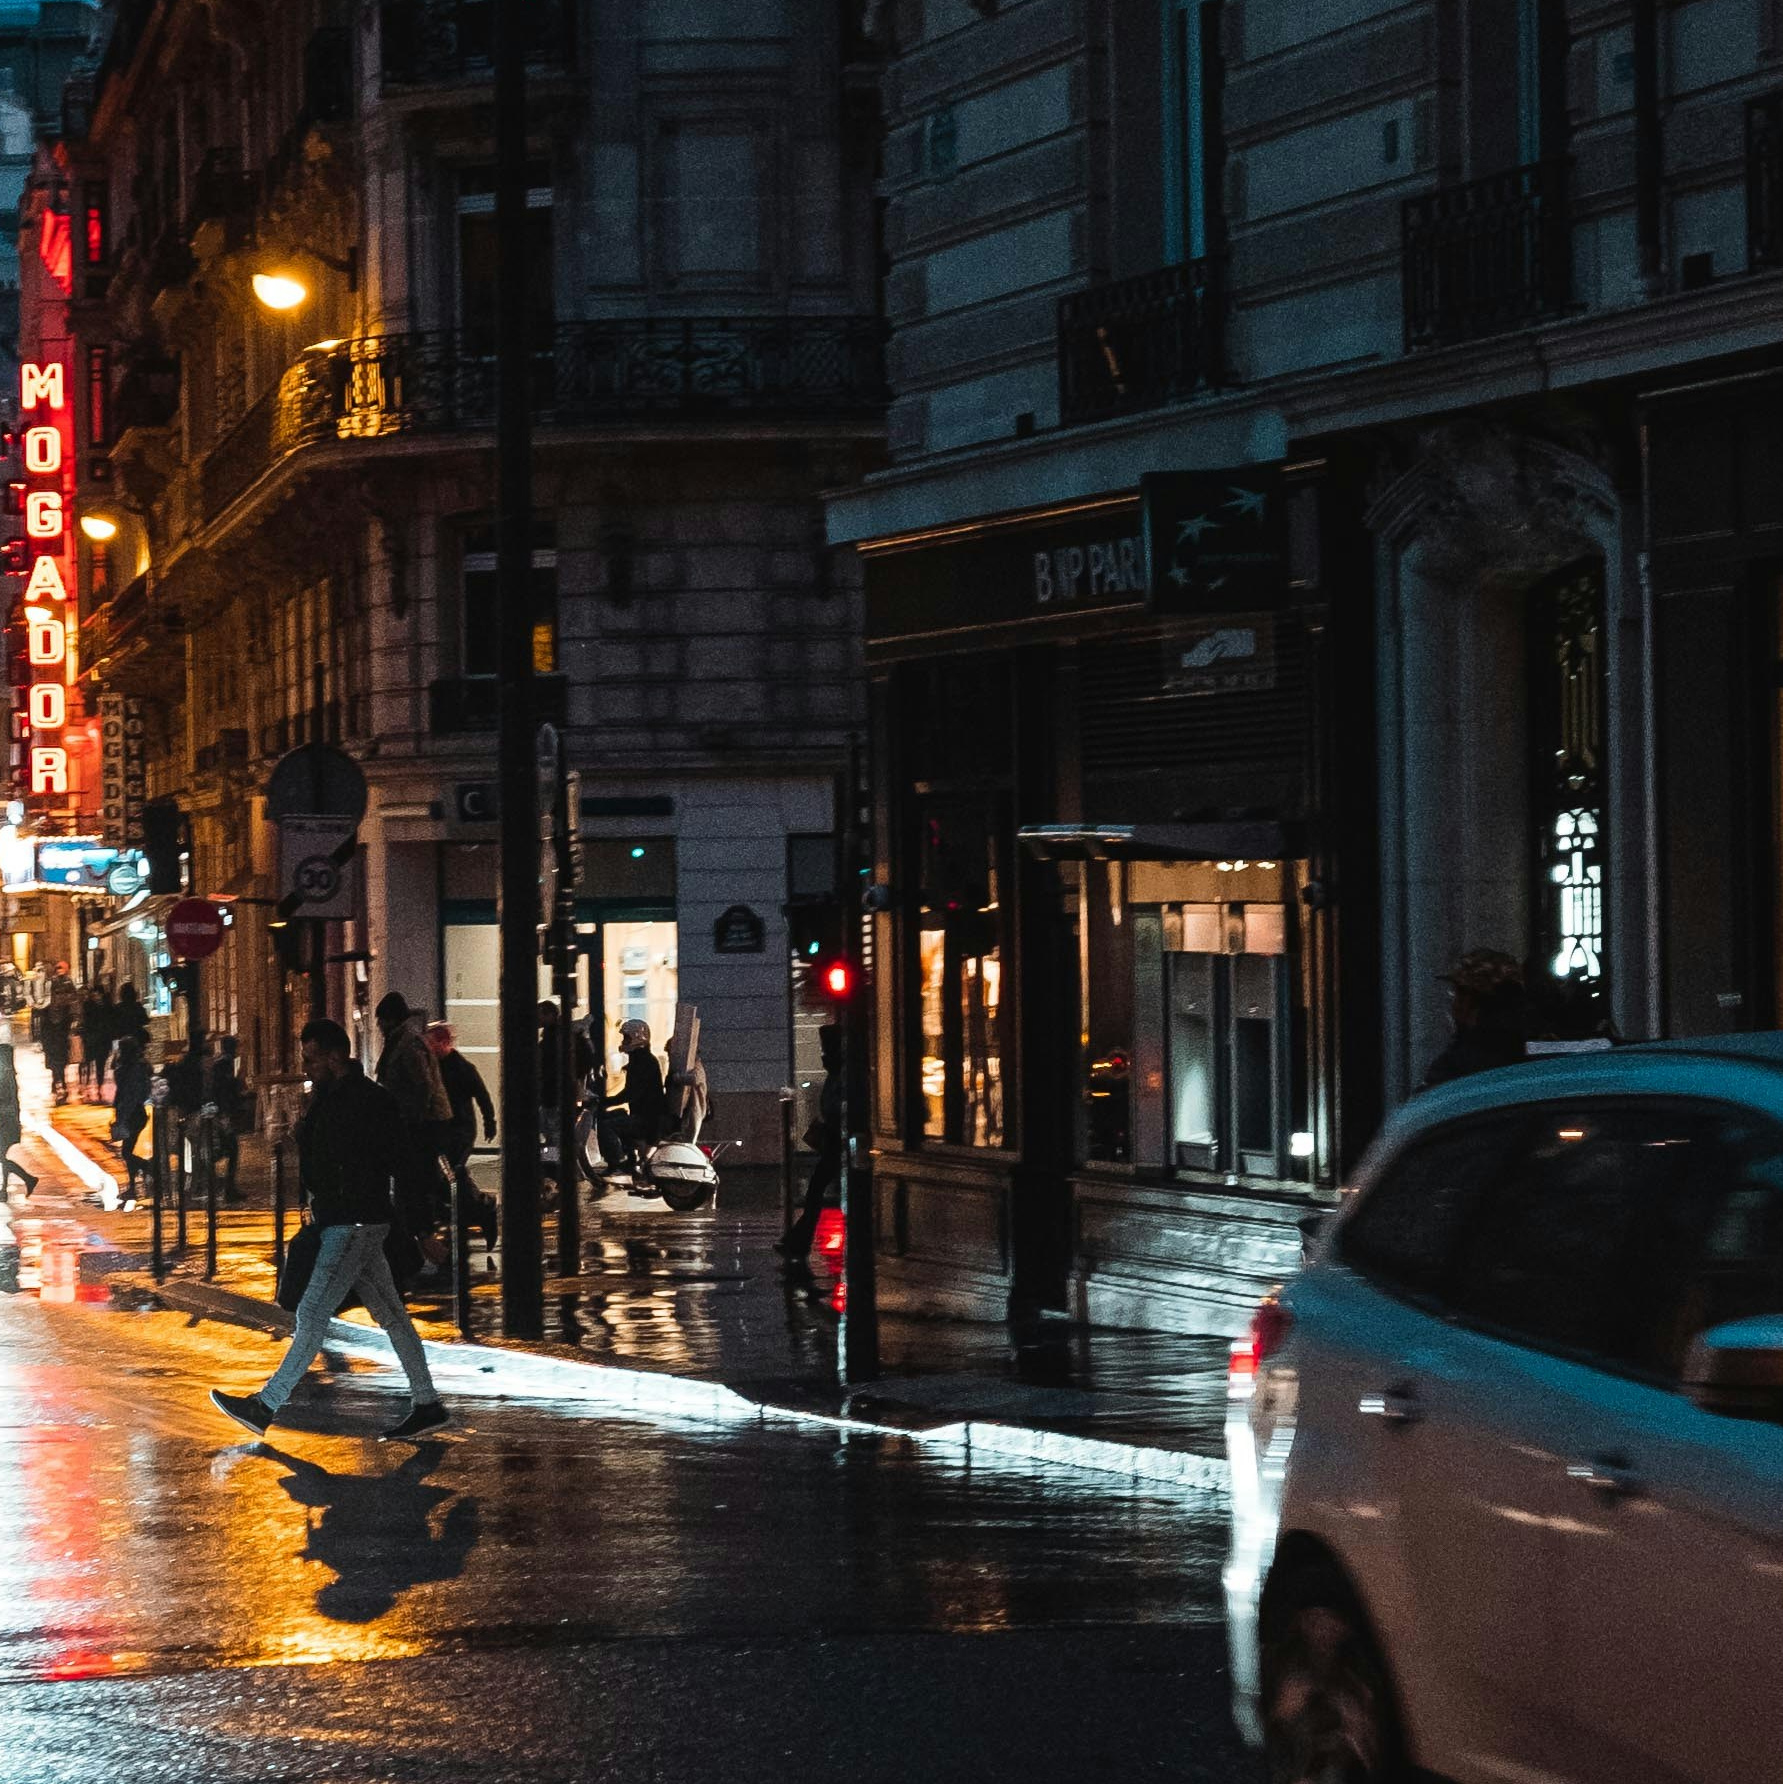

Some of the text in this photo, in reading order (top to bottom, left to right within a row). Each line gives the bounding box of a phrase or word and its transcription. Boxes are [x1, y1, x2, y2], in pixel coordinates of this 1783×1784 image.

[21, 361, 69, 794] MOGADOR
[103, 699, 123, 841] MOGADOR
[303, 869, 331, 890] 30
